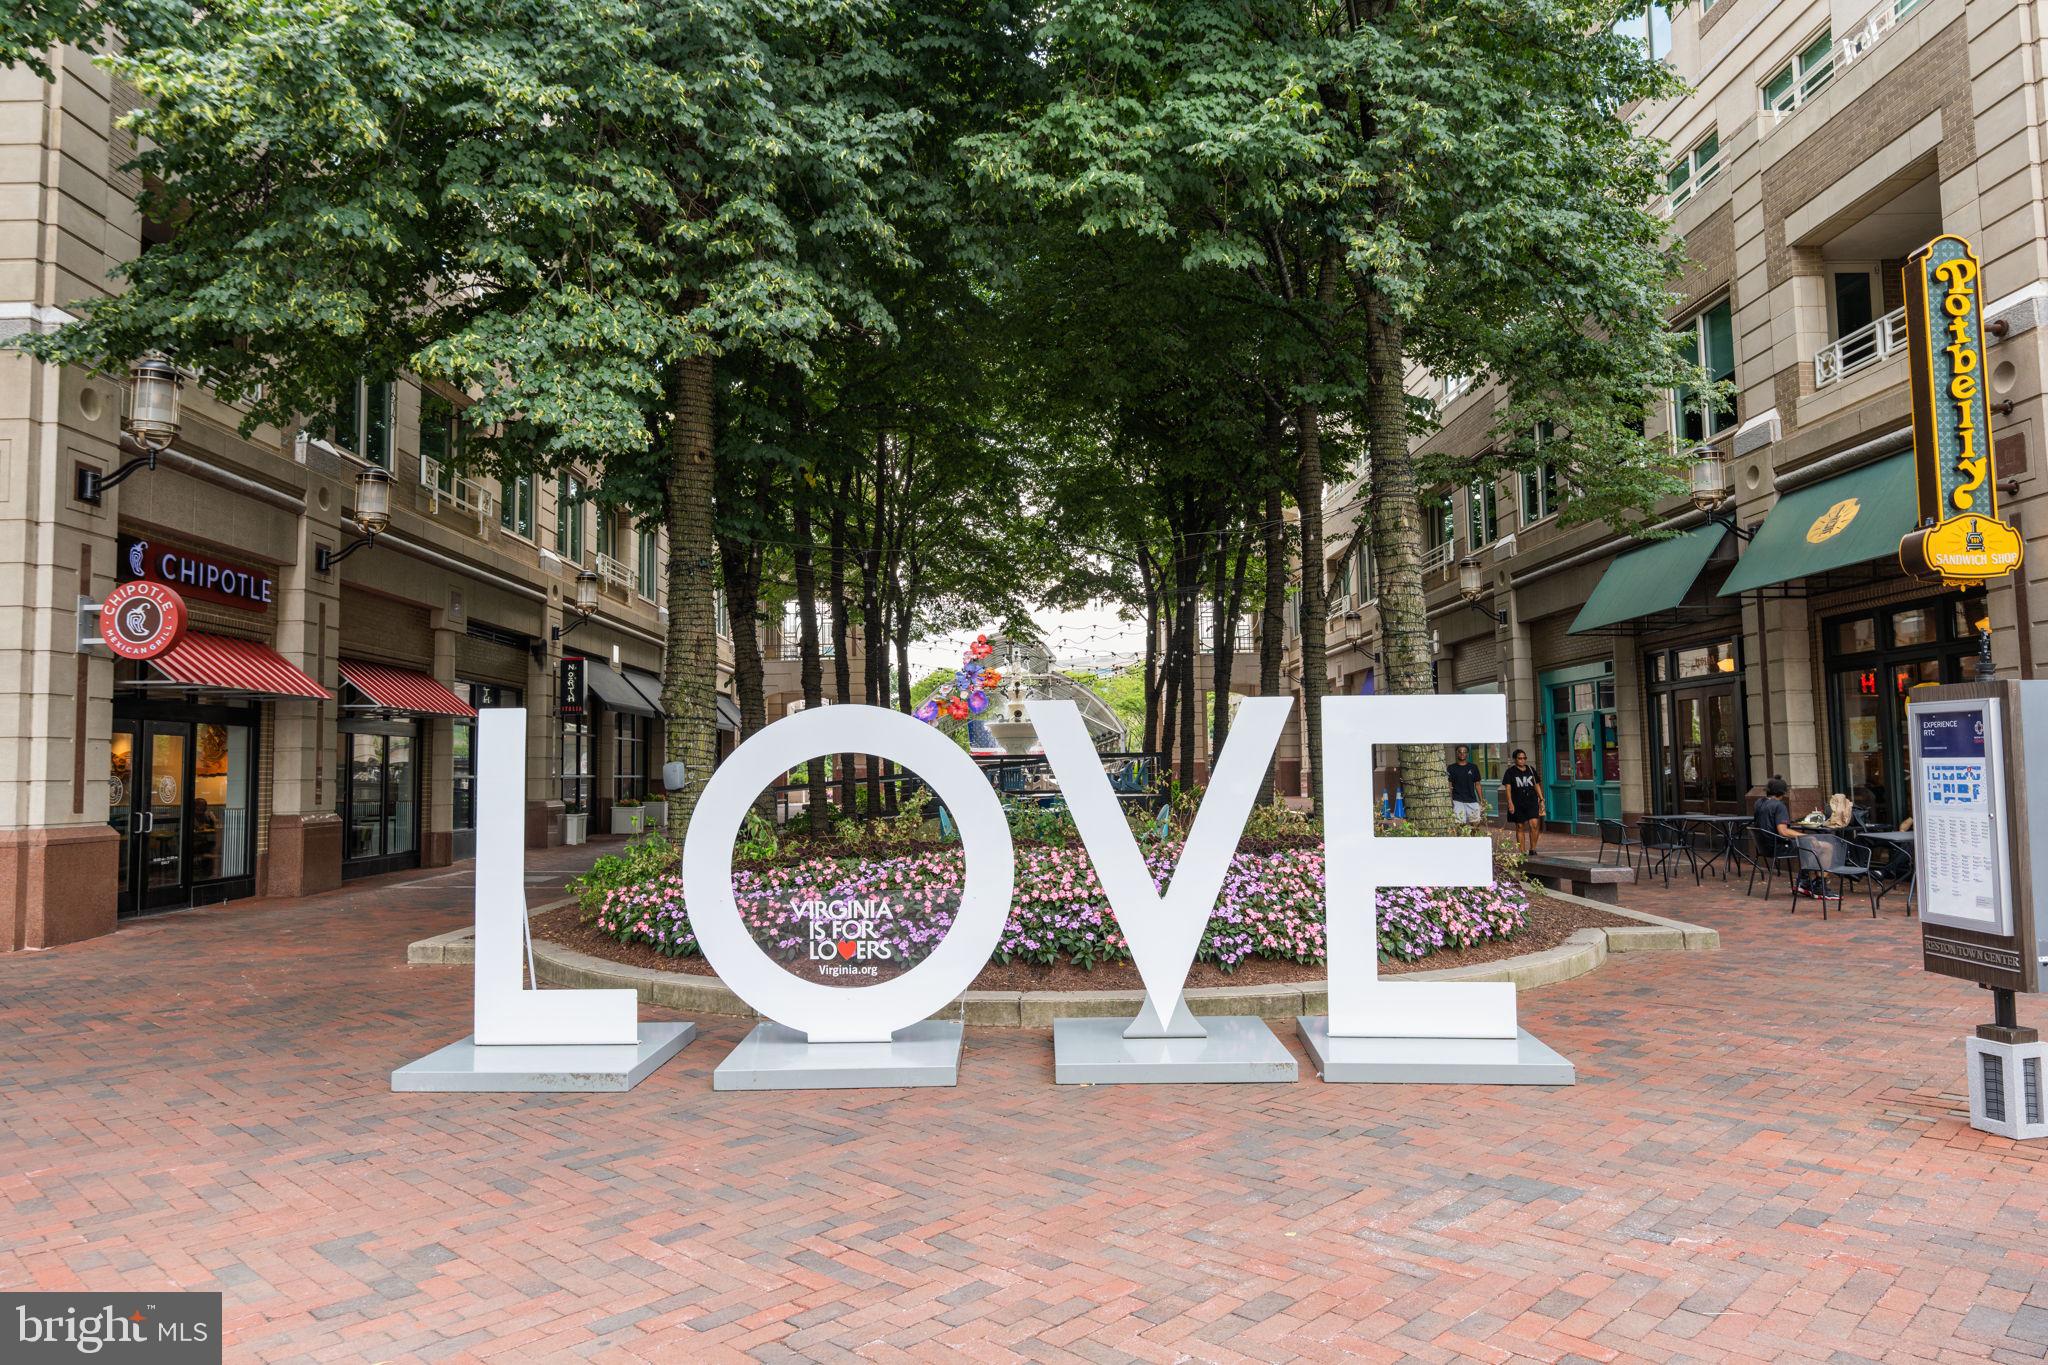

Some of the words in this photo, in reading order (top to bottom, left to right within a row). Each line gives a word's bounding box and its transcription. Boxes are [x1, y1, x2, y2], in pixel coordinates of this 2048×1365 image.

[1936, 258, 1987, 510] Potbelly
[1936, 553, 1988, 566] SANDWICH
[1991, 552, 2017, 565] SHOP
[162, 553, 272, 603] CHIPOTLE
[104, 583, 173, 615] CHIPOTLE
[106, 629, 148, 654] MEXICAN
[149, 625, 173, 650] GRILL
[566, 663, 576, 703] NORTH
[1923, 720, 1958, 729] EXPERIENCE
[1923, 729, 1935, 737] RTC
[1515, 775, 1534, 788] MK
[474, 693, 1518, 1046] LOVE
[790, 899, 893, 920] VIRGINIA
[809, 920, 826, 940] IS
[832, 919, 880, 940] FOR
[1925, 939, 1957, 955] RESTON
[1956, 945, 1984, 961] TOWN
[1984, 951, 2020, 967] CENTER
[818, 964, 878, 977] Virginia.org
